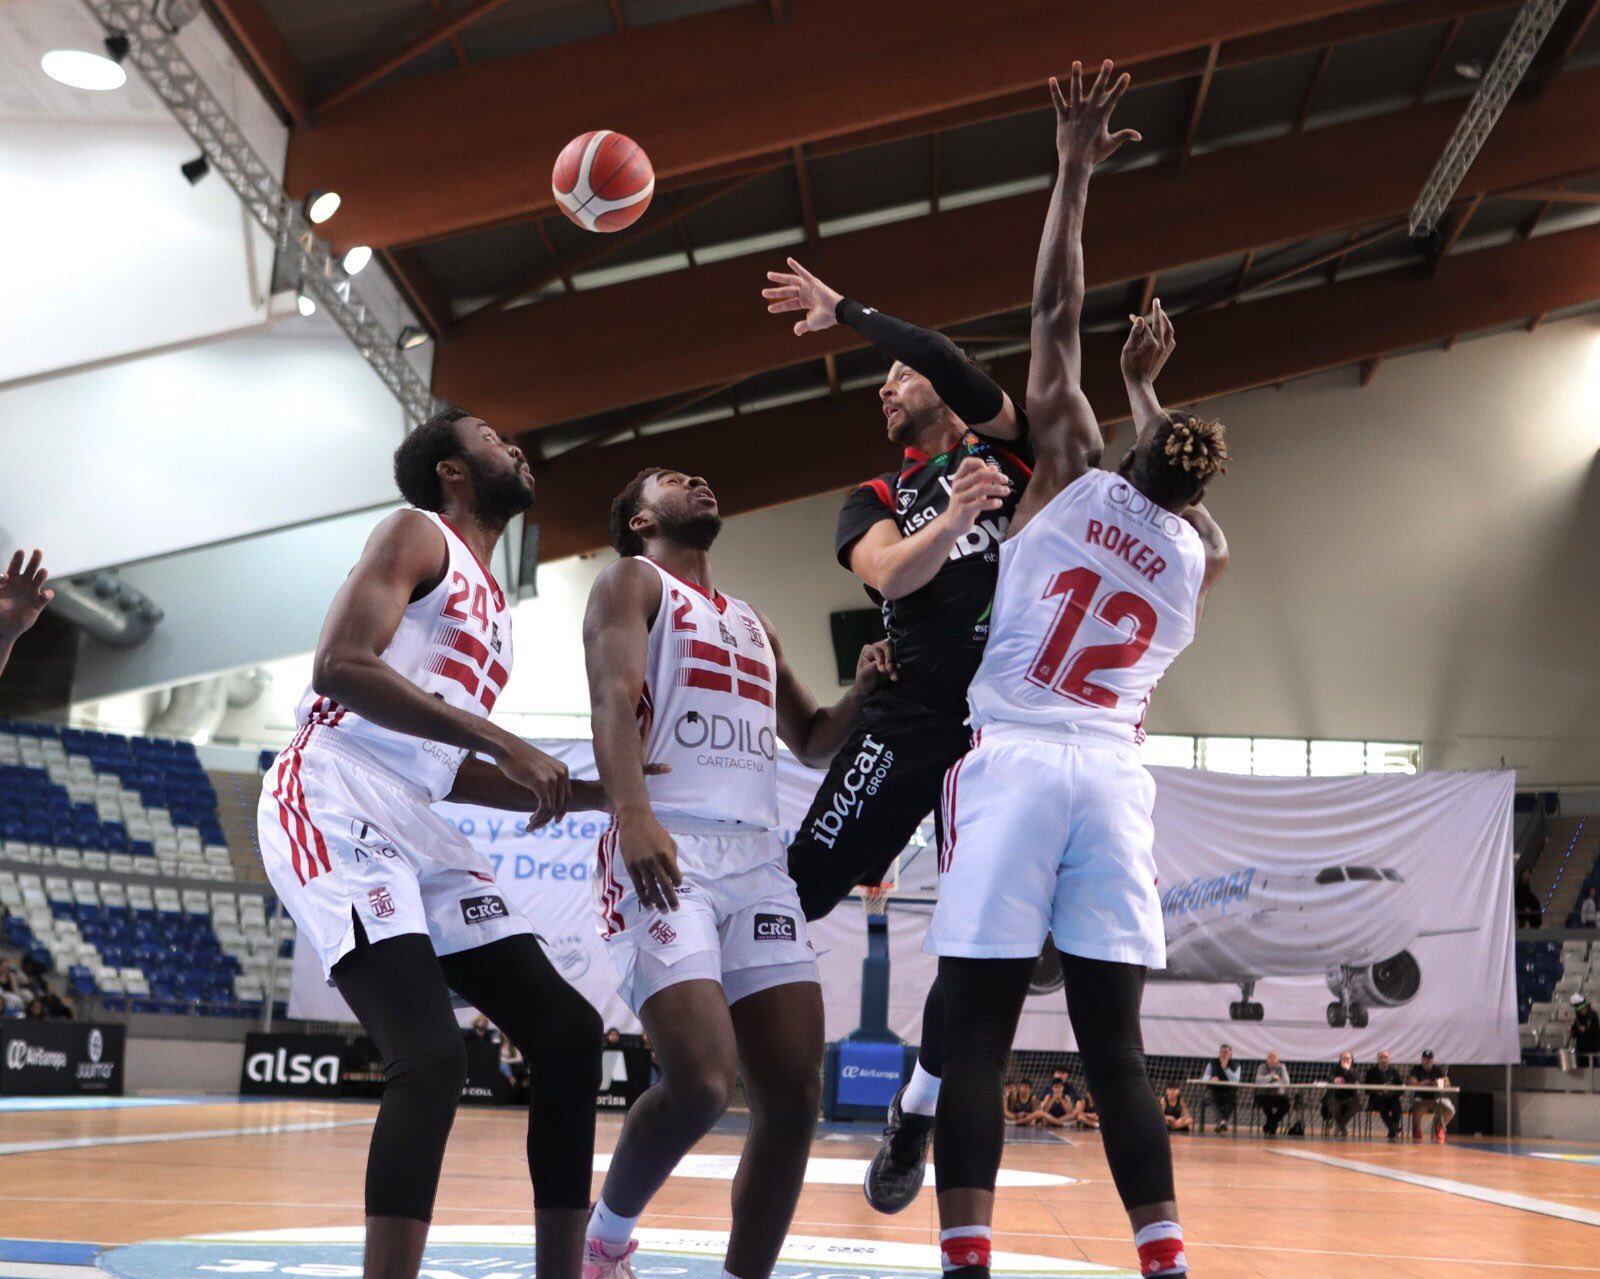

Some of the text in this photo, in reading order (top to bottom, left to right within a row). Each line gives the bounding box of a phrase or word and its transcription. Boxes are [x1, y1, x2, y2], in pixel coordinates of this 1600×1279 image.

[1109, 483, 1182, 537] ODILO
[1085, 518, 1167, 583] ROKER
[440, 571, 490, 635] 24
[671, 588, 697, 633] 2
[1024, 566, 1158, 709] 12
[674, 711, 775, 762] ODILO
[811, 733, 885, 850] ibacar
[865, 750, 896, 796] GROUP
[487, 816, 504, 844] y
[465, 903, 504, 922] CRC
[757, 922, 794, 937] CRC
[247, 1047, 341, 1085] alsa
